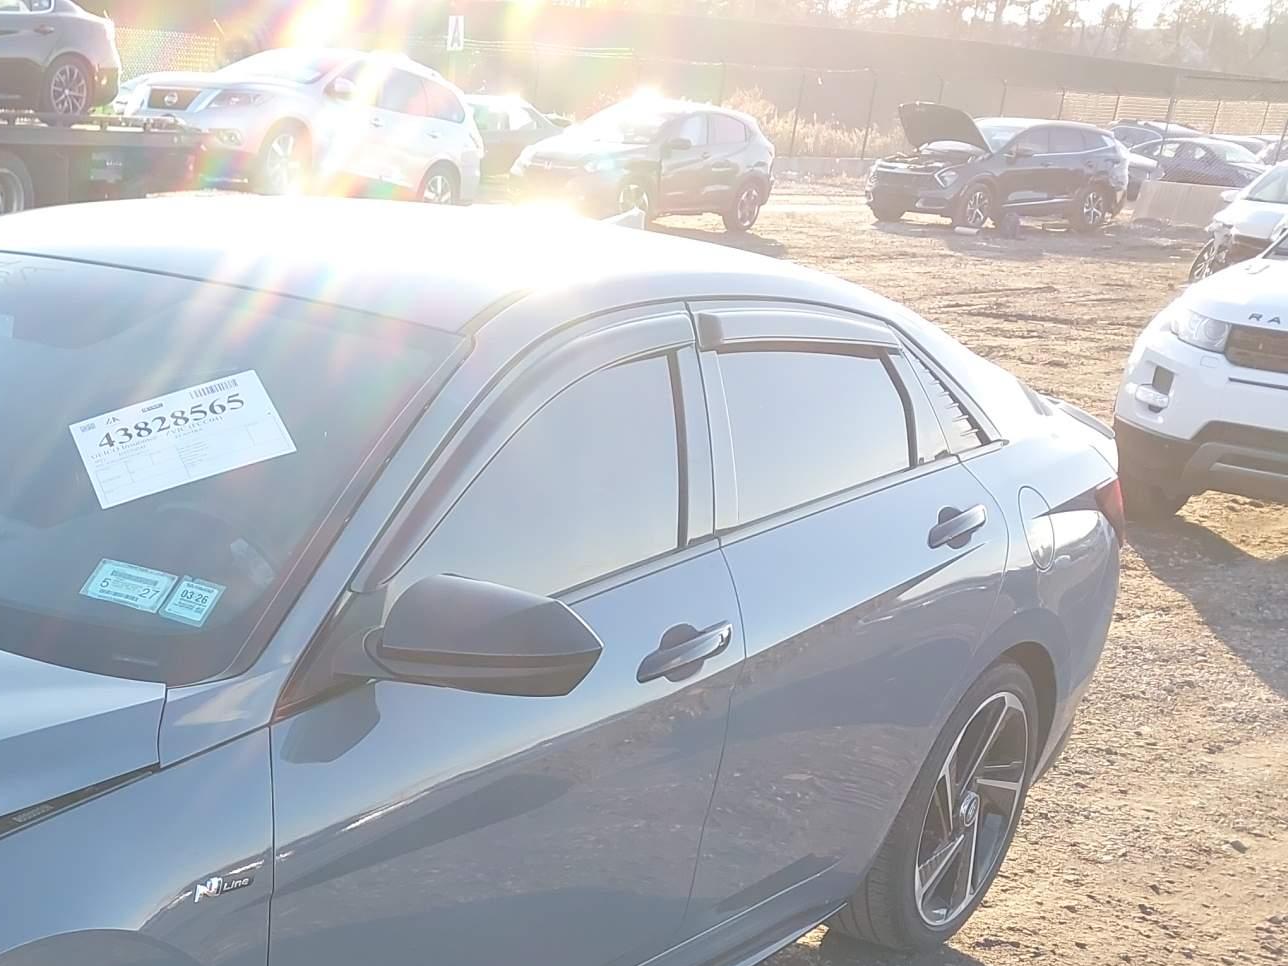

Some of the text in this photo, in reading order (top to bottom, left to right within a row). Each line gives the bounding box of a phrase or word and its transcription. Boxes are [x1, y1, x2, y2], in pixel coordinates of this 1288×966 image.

[98, 393, 245, 448] 43828565
[100, 578, 111, 589] 5
[138, 588, 160, 600] 27
